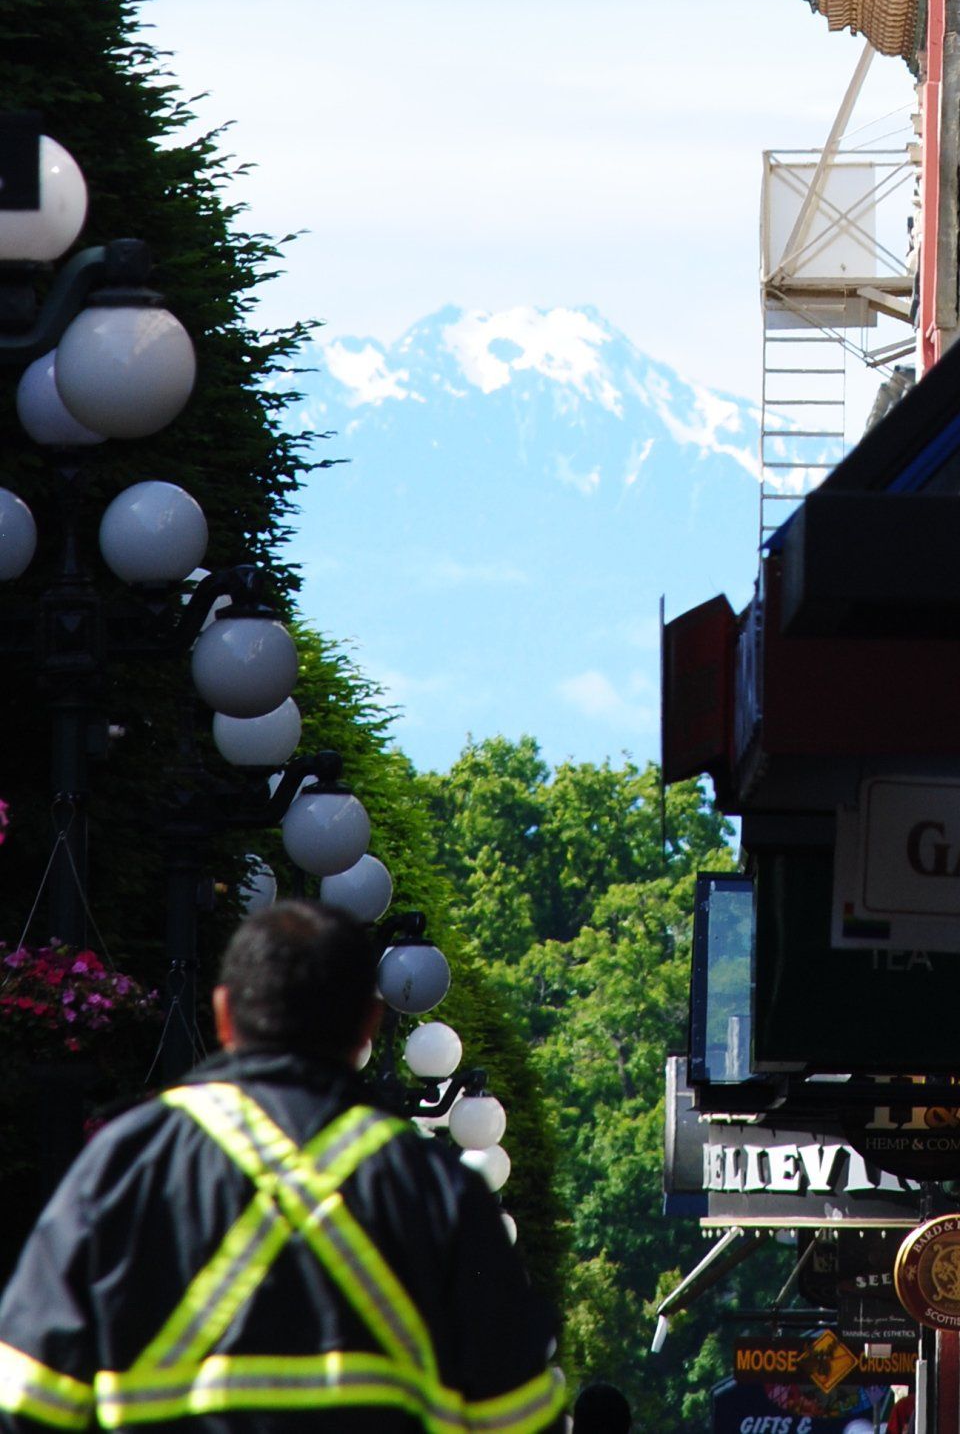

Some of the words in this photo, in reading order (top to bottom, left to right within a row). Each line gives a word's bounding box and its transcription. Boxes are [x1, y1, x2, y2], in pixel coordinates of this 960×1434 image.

[866, 1137, 909, 1151] HEMP
[911, 1138, 924, 1151] &
[913, 1223, 943, 1254] BARD
[943, 1220, 955, 1233] &
[735, 1349, 798, 1372] MOOSE
[739, 1415, 793, 1434] GIFTS
